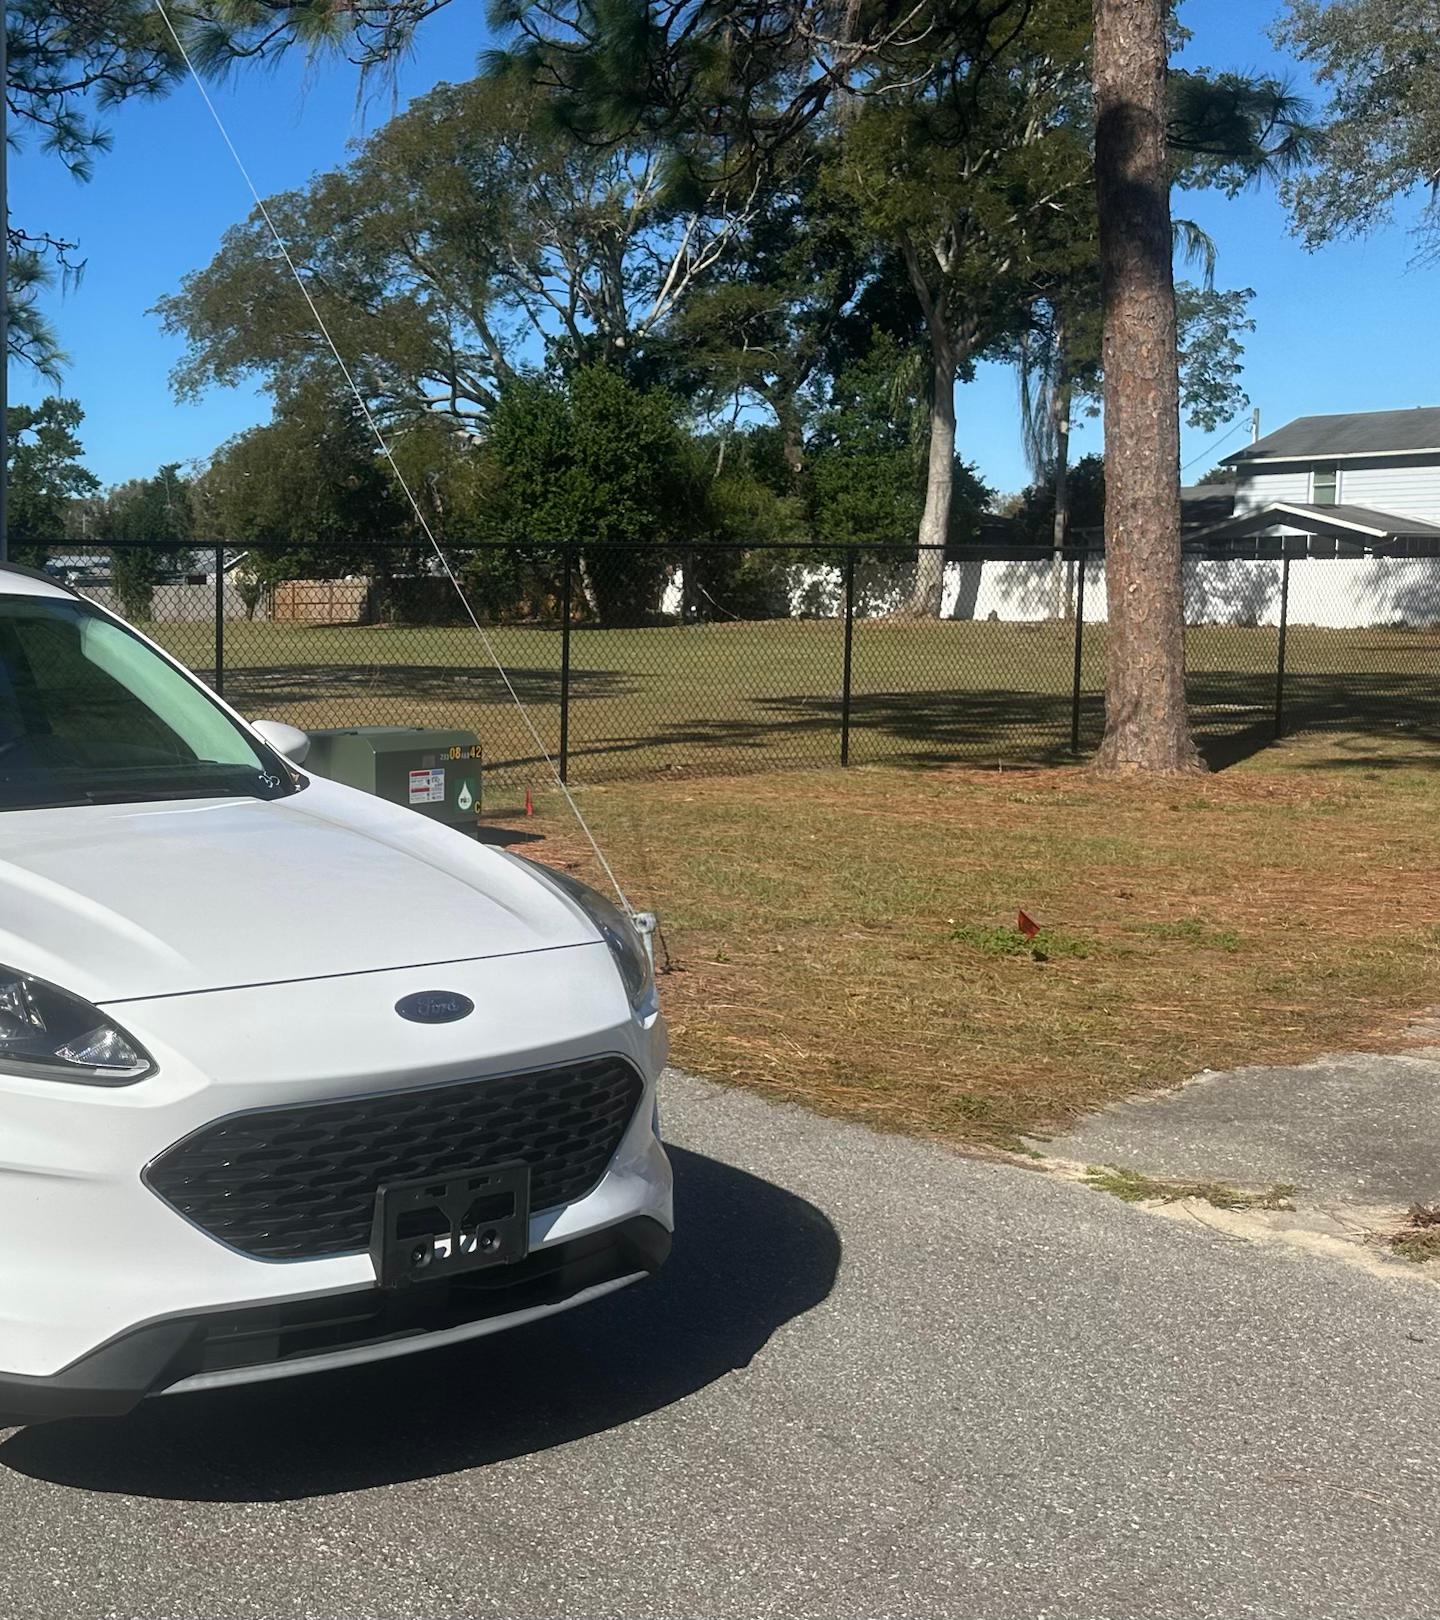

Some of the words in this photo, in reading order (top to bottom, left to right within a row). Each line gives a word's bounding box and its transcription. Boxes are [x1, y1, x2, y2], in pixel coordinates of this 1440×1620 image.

[449, 747, 461, 759] 08
[470, 746, 481, 758] 42
[417, 997, 458, 1016] Ford
